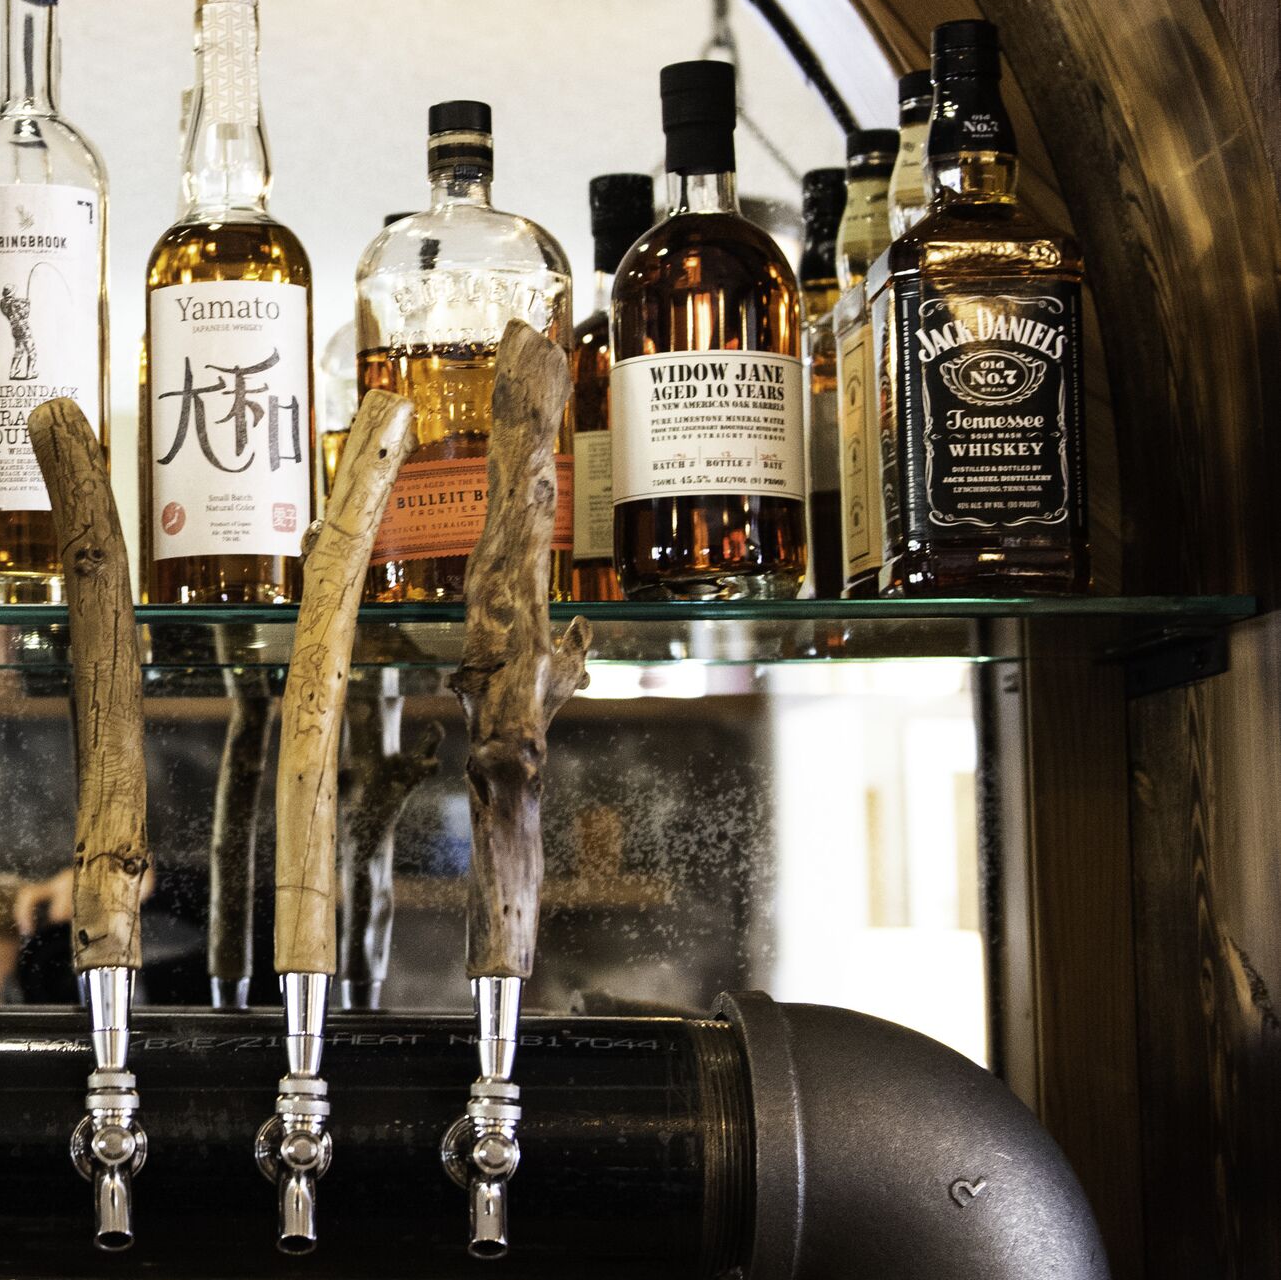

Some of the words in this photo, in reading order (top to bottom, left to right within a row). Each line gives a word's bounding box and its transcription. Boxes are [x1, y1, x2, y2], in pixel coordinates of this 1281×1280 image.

[962, 121, 999, 133] No.7
[175, 296, 280, 322] Yamato
[192, 324, 230, 333] JAPANESE
[232, 323, 263, 331] WHISKY
[914, 319, 976, 362] JACK
[976, 304, 1068, 360] DANIEL'S
[979, 360, 1005, 369] Old
[650, 362, 729, 384] WIDOW
[735, 362, 784, 384] JANE
[969, 370, 1018, 386] No.7
[651, 384, 698, 401] AGED
[705, 384, 728, 398] 10
[734, 384, 785, 401] YEARS
[156, 347, 302, 473] 大和
[651, 404, 659, 412] IN
[662, 402, 680, 410] NEW
[682, 401, 730, 409] AMERICAN
[752, 401, 785, 411] BARRELS
[674, 415, 722, 424] LIMESTONE
[726, 415, 761, 423] MINERAL
[763, 417, 785, 425] WATER
[946, 409, 1045, 430] Tennessee
[651, 434, 677, 442] BLEND
[747, 433, 786, 442] BOURBONS
[905, 409, 914, 459] LYNCHBURG
[948, 442, 1044, 457] WHISKEY
[652, 461, 686, 471] BATCH
[705, 459, 743, 467] BOTTLE
[763, 461, 783, 470] DATE
[424, 481, 445, 489] AGED
[458, 478, 473, 486] THE
[680, 475, 711, 484] 45.5%
[715, 476, 747, 484] ALC/VOL
[906, 461, 916, 509] TENNESSEE
[208, 494, 230, 502] Small
[232, 494, 253, 502] Batch
[396, 491, 466, 509] BULLEIT
[206, 503, 234, 512] Natural
[236, 504, 256, 512] Color
[410, 505, 477, 517] FRONTIER
[431, 520, 480, 531] STRAIGHT
[330, 1032, 425, 1045] HEAT
